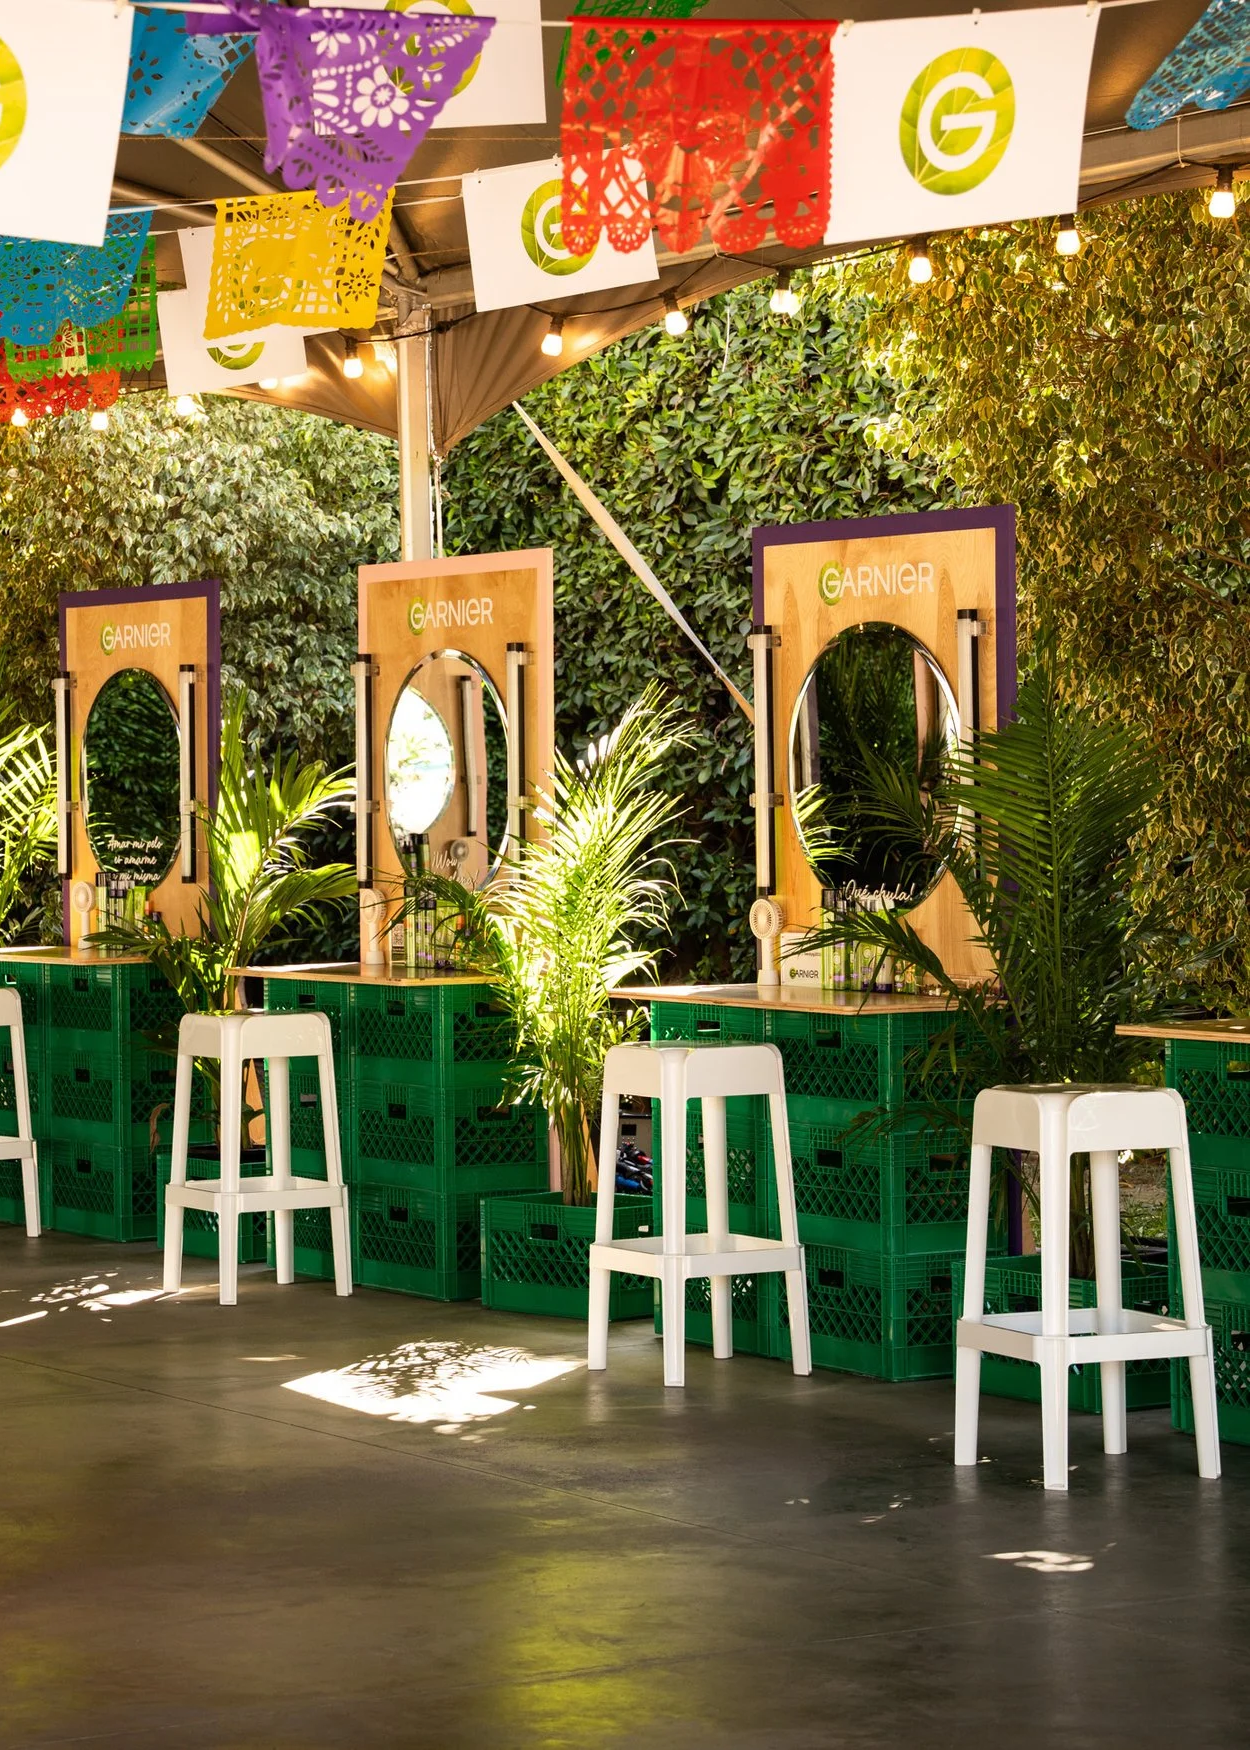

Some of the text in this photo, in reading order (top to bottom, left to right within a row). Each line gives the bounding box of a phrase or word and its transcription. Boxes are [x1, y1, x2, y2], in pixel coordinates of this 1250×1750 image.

[916, 71, 998, 172] G
[822, 561, 934, 599] GARNIER
[410, 597, 494, 630] GARNIER
[102, 622, 171, 650] GARNIER
[146, 836, 164, 853] pelo
[873, 882, 916, 901] chula!
